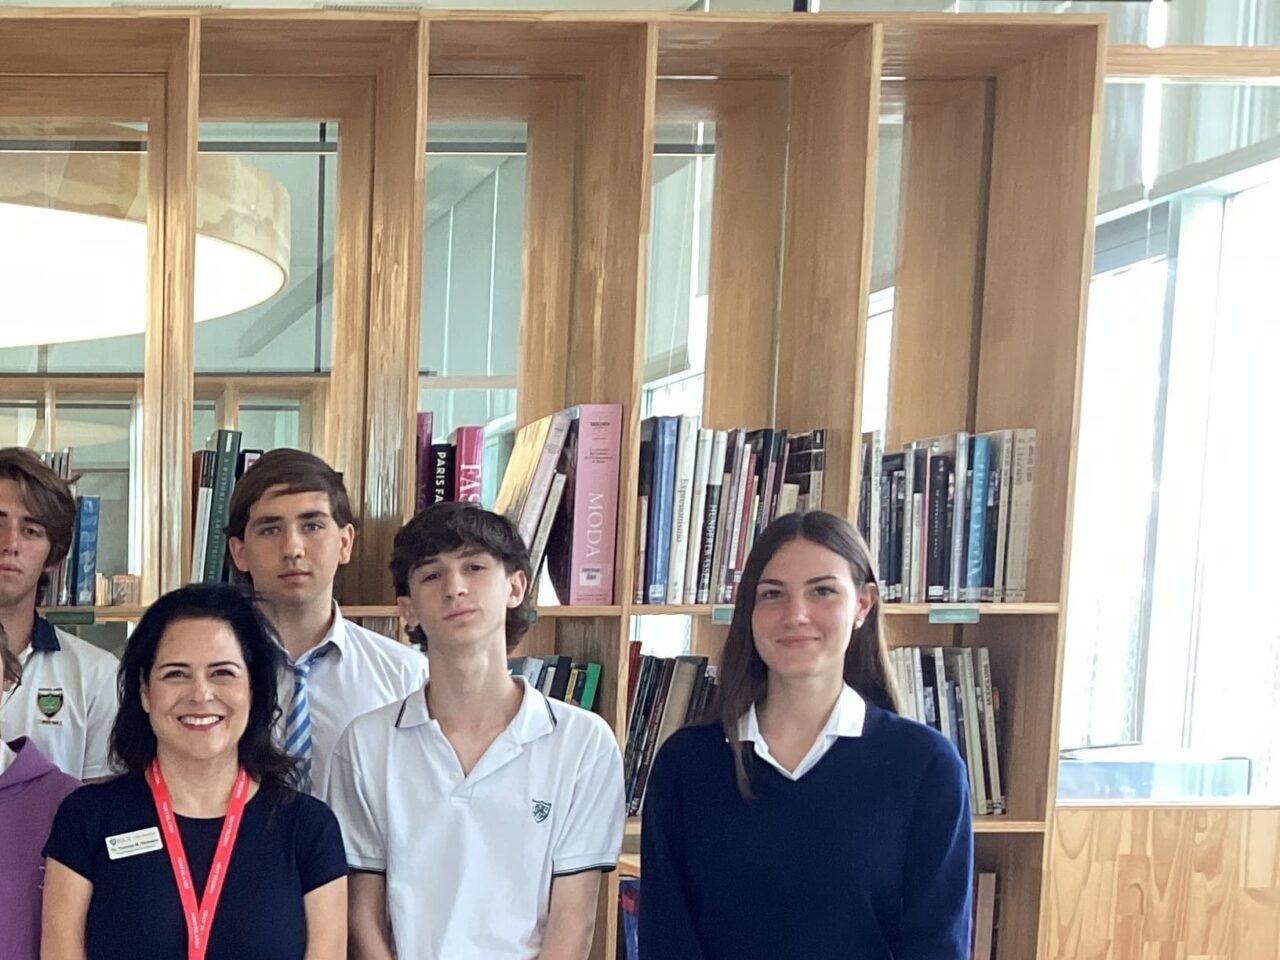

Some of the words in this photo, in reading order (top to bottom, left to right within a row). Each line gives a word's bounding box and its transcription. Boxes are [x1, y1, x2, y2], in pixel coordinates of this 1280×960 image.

[219, 467, 228, 501] HISTORY
[435, 451, 447, 486] PARIS
[585, 492, 604, 558] MODA
[676, 478, 689, 543] Expresionismo
[208, 518, 222, 582] ARCHITECTURE
